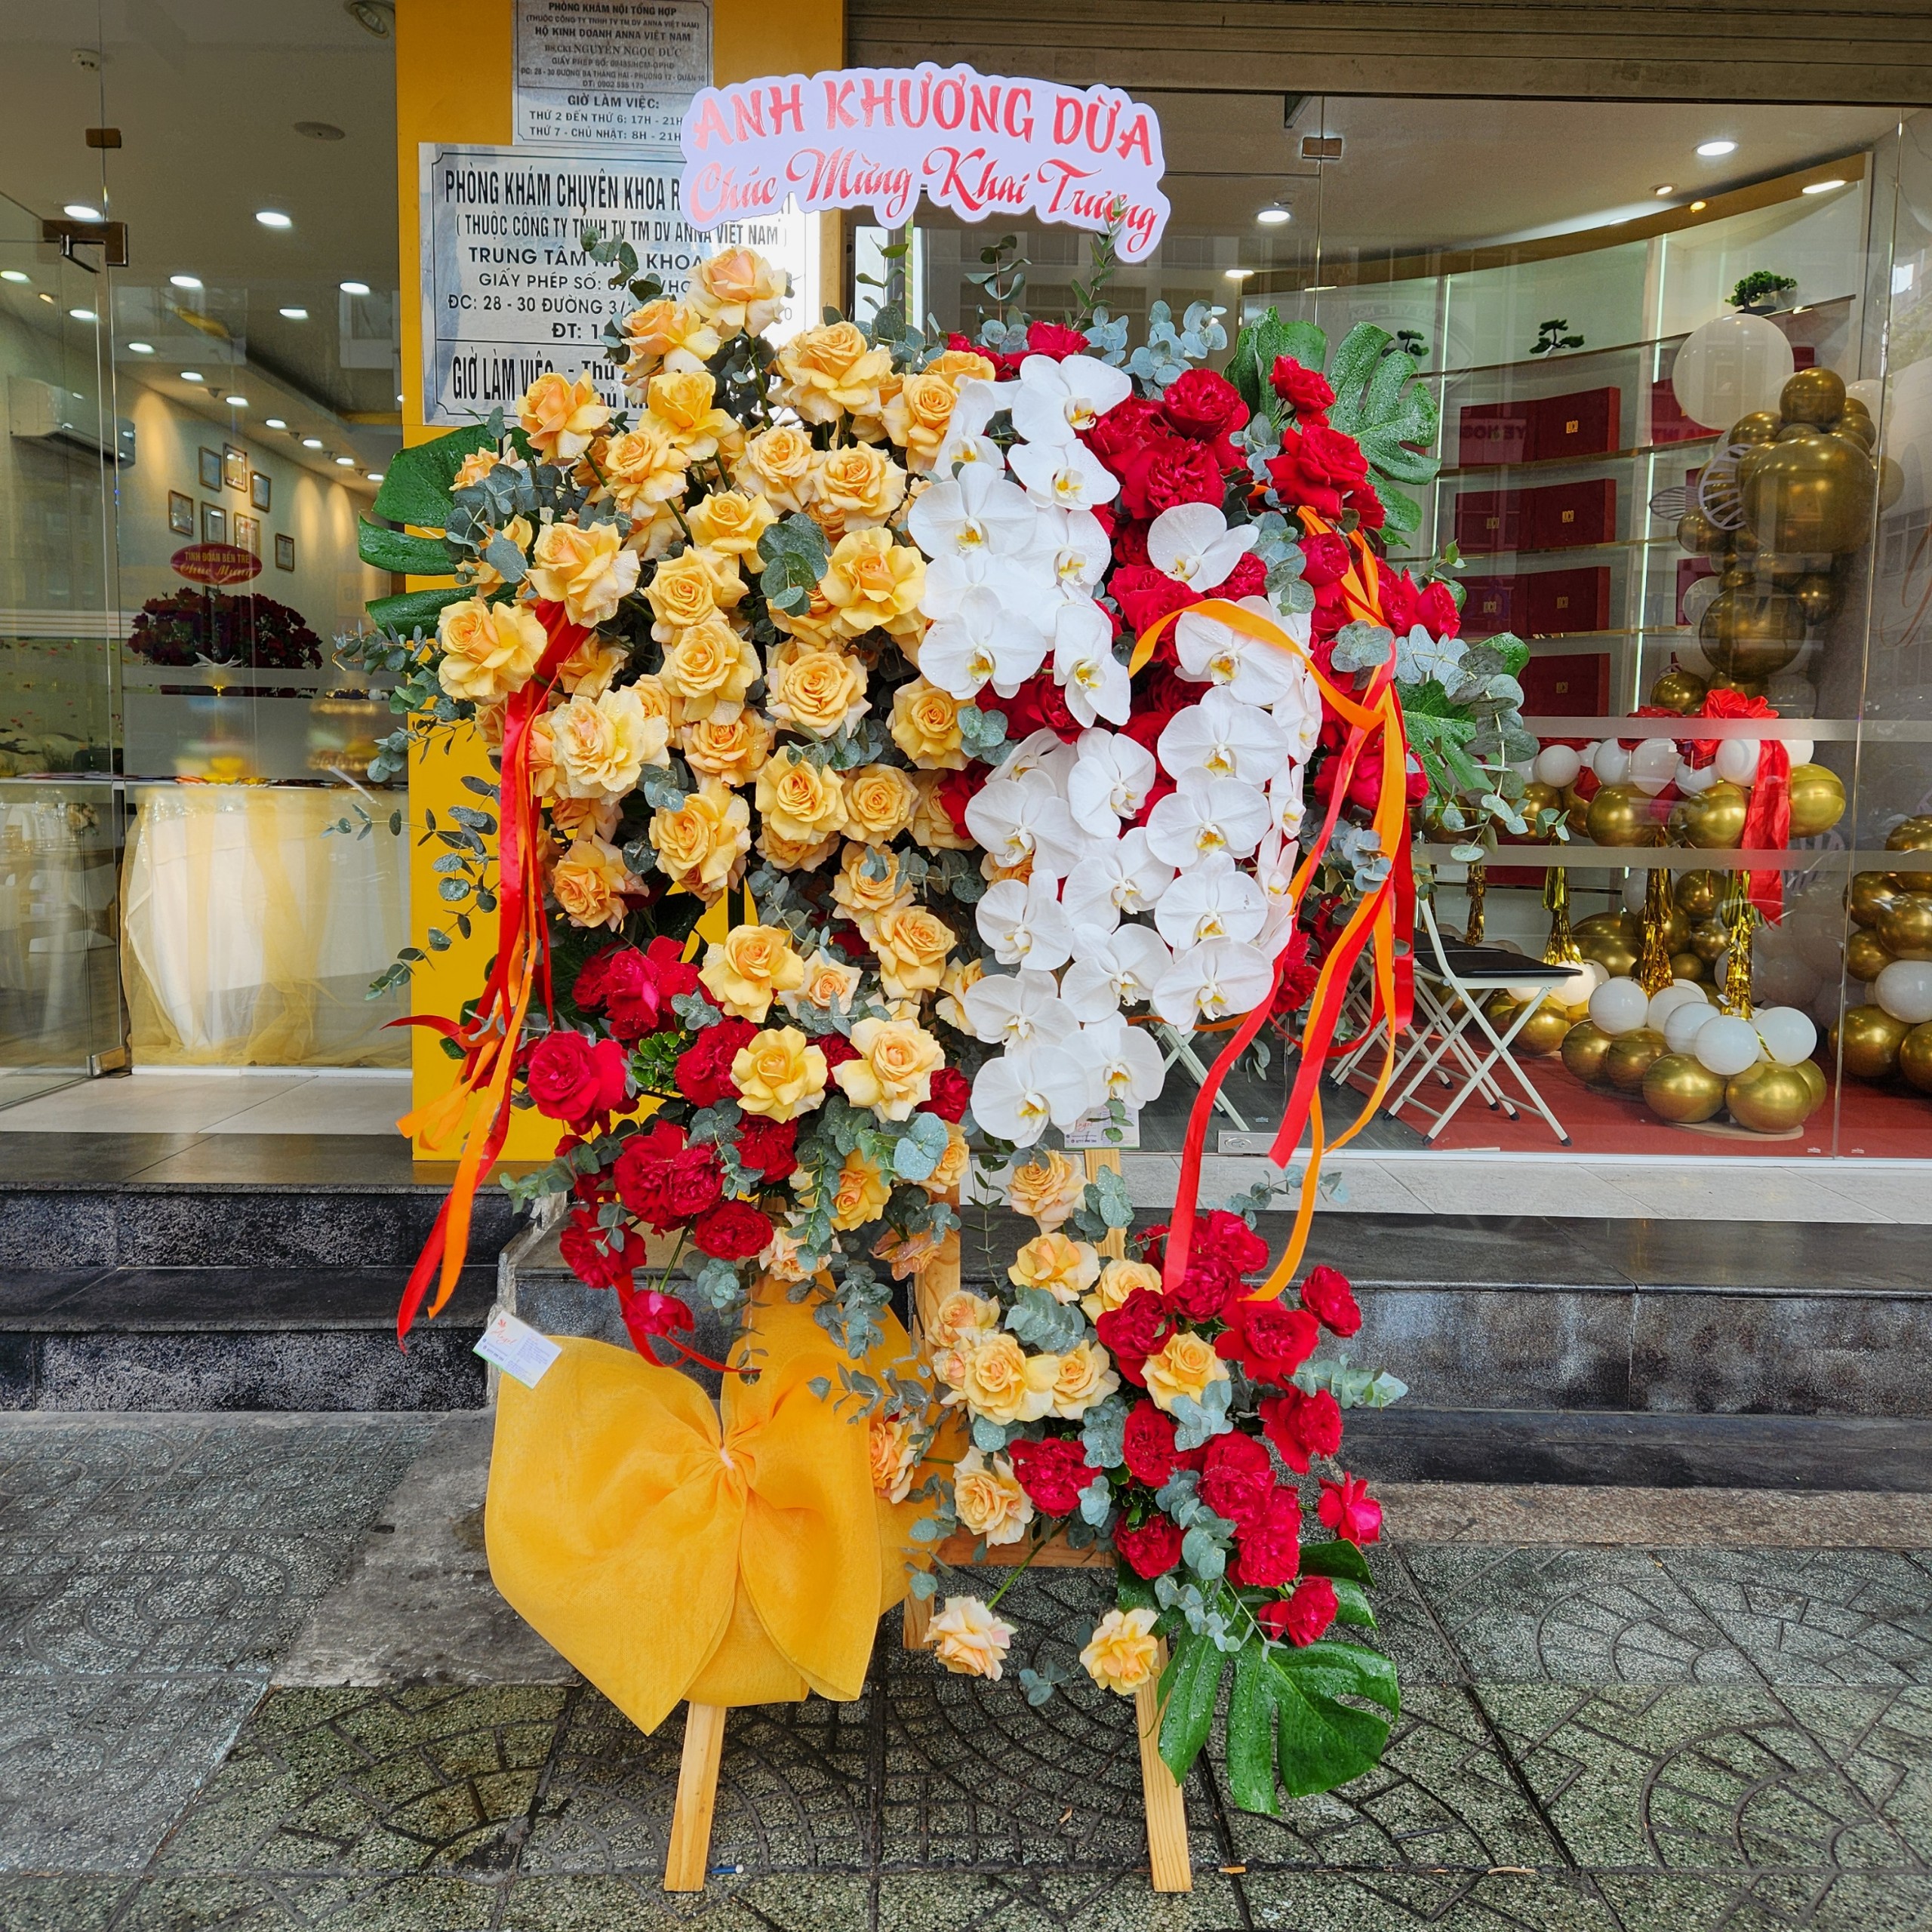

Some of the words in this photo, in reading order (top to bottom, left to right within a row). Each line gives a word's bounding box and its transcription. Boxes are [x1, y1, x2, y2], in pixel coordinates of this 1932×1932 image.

[552, 27, 575, 37] KINH
[615, 31, 641, 39] ANNA
[669, 32, 691, 42] NAM
[568, 93, 589, 106] GIỜ
[594, 94, 621, 108] LÀM
[626, 95, 660, 110] VIỆC:
[529, 109, 552, 120] THỨ
[555, 112, 562, 121] 2
[566, 109, 588, 122] ĐẾN
[591, 112, 614, 123] THỨ
[617, 114, 627, 124] 6:
[632, 115, 651, 125] 17H
[692, 83, 808, 150] ANH
[823, 71, 1035, 144] KHƯƠNG
[1052, 91, 1154, 167] DỪA
[529, 125, 551, 136] THỨ
[555, 128, 561, 136] 7
[571, 125, 592, 137] CHỦ
[596, 128, 627, 140] NHẬT:
[632, 131, 647, 140] 8H
[445, 162, 499, 205] PHÒNG
[504, 165, 551, 206] KHÁM
[557, 168, 619, 209] CHUYÊN
[624, 177, 666, 211] KHOA
[689, 160, 778, 223] Chúc
[786, 146, 913, 218] Mừng
[923, 146, 1029, 211] Khai
[465, 211, 508, 240] THUỘC
[512, 212, 549, 237] CÔNG
[553, 217, 567, 238] TY
[611, 220, 626, 240] TV
[630, 220, 650, 241] TM
[654, 221, 670, 242] DV
[749, 225, 778, 245] NAM
[469, 247, 537, 264] TRUNG
[544, 245, 586, 266] TÂM
[479, 267, 521, 287] GIẤY
[527, 272, 568, 288] PHÉP
[574, 272, 601, 291] SỐ:
[448, 294, 477, 309] ĐC:
[483, 295, 501, 310] 28
[517, 297, 536, 312] 30
[542, 294, 603, 314] ĐƯỜNG
[551, 322, 581, 339] ĐT:
[453, 346, 477, 399] GIỜ
[483, 349, 515, 401] LÀM
